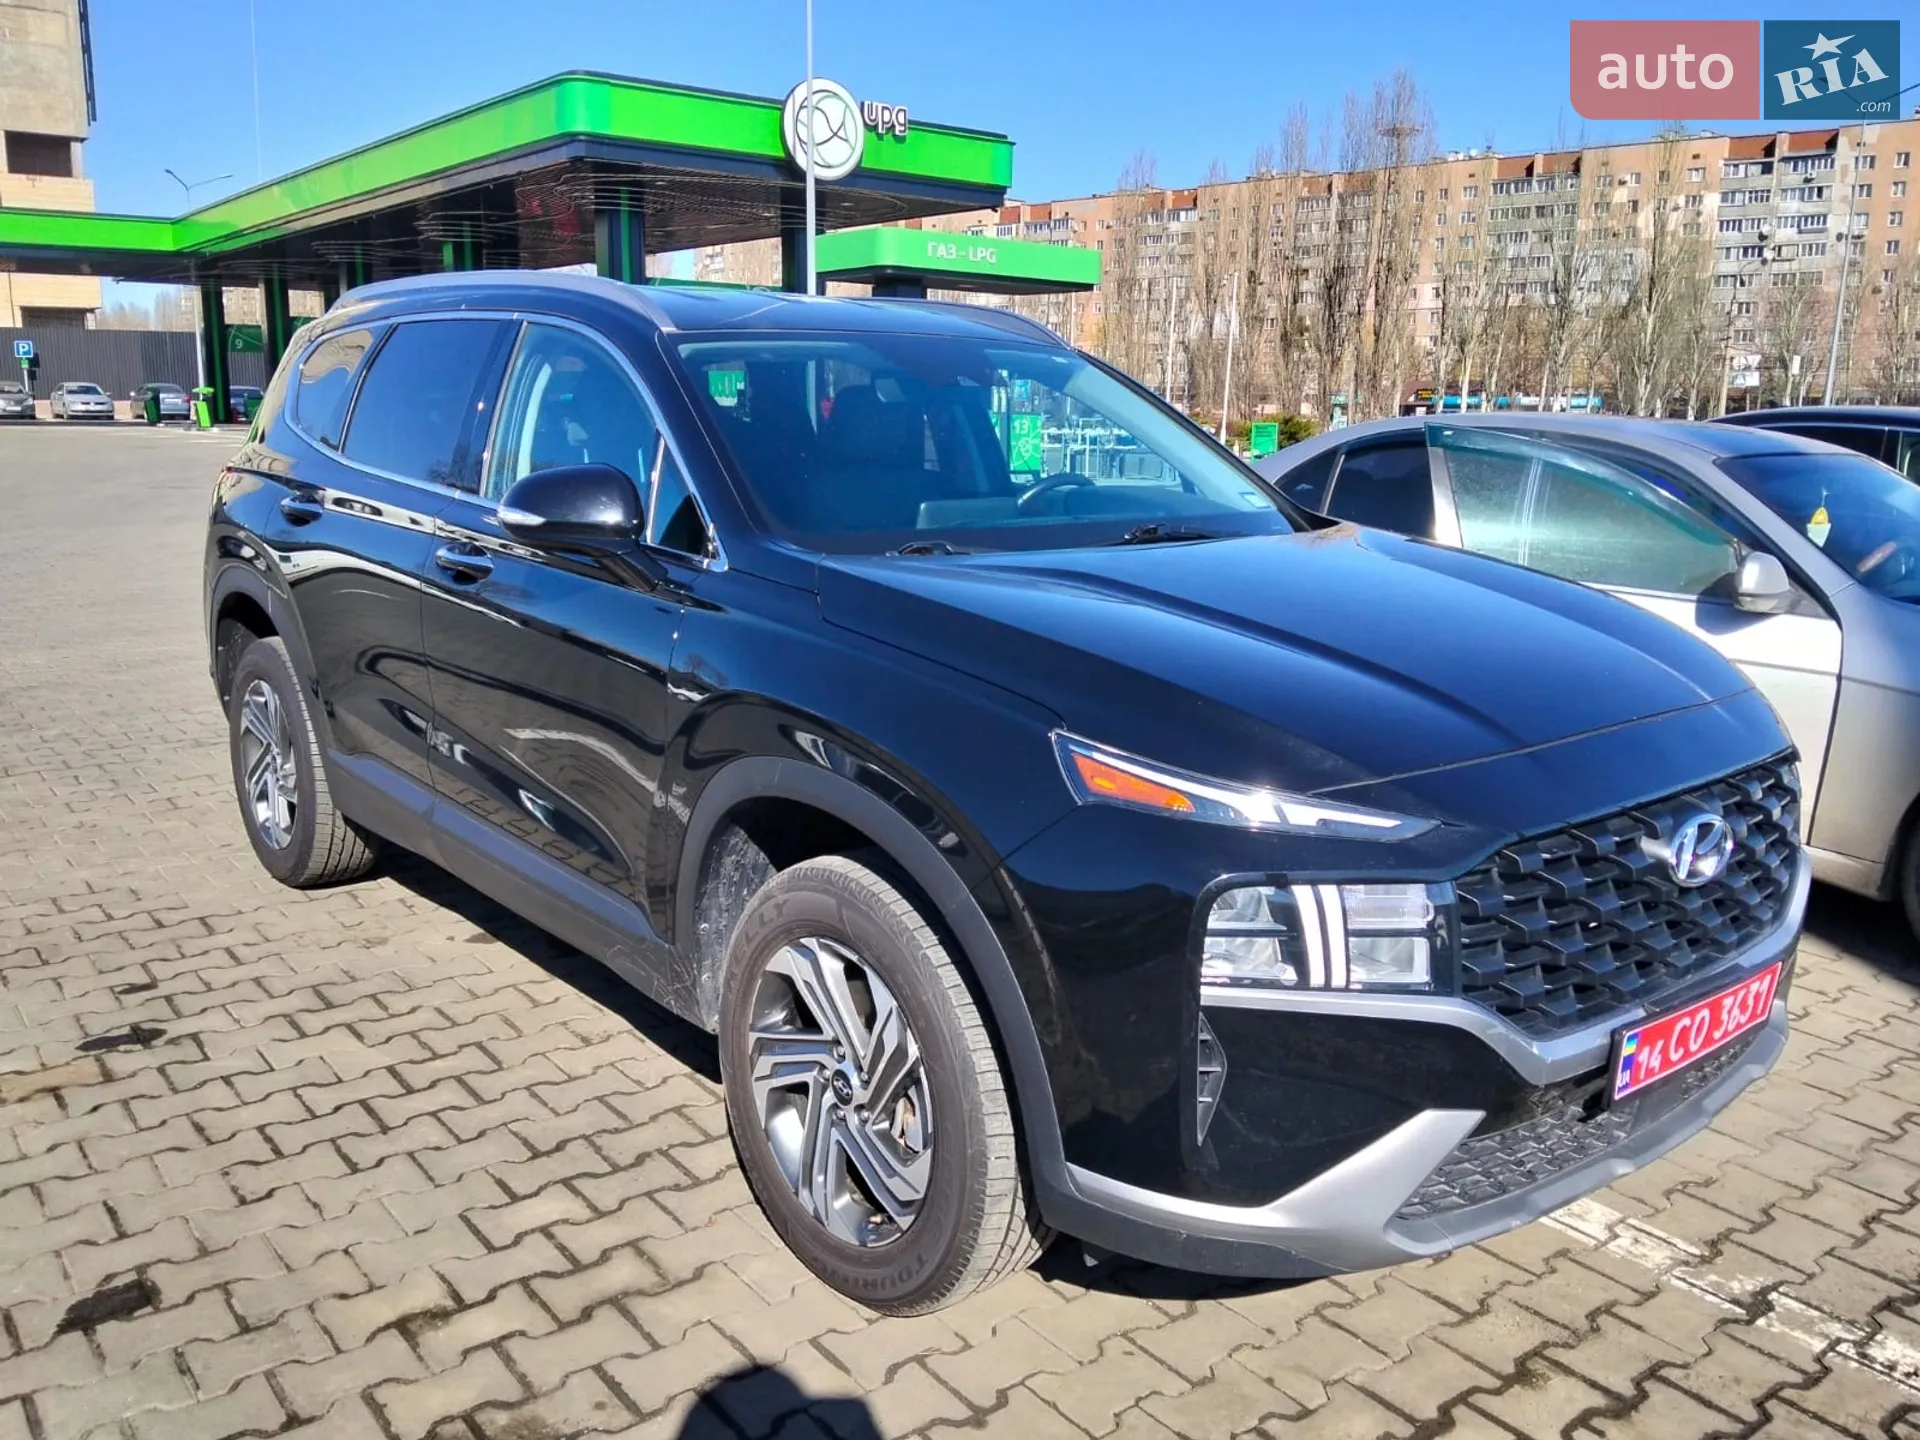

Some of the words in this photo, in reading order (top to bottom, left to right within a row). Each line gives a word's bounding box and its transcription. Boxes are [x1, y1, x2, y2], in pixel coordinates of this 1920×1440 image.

[862, 100, 908, 135] upg
[235, 338, 243, 349] 9
[1013, 419, 1029, 434] 13
[1637, 1039, 1664, 1080] 14
[1669, 1008, 1710, 1062] CO
[1713, 973, 1771, 1040] 3631
